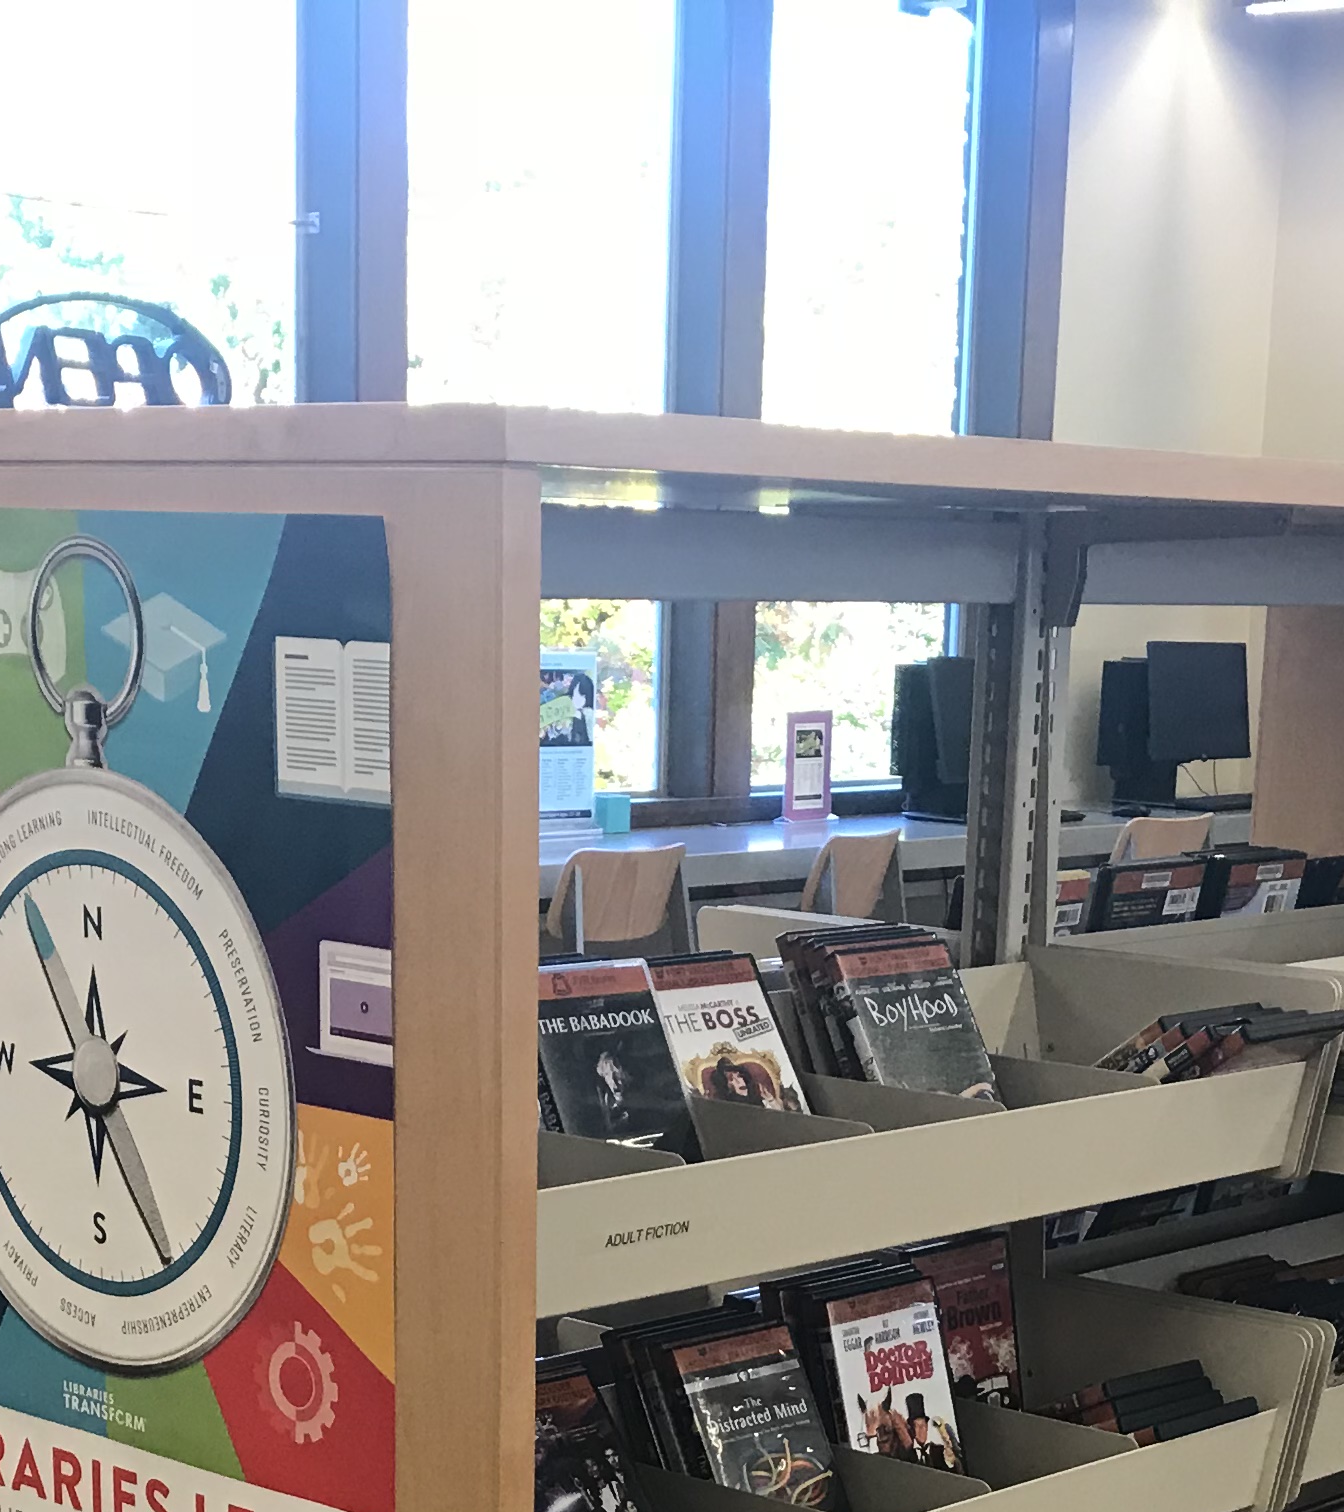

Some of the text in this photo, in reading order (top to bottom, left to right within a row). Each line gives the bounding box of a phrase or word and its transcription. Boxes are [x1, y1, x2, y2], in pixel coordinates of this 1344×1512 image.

[16, 810, 62, 843] LEARNING
[87, 809, 204, 900] INTELLECTUAL FREEDOM
[83, 903, 102, 940] N
[218, 928, 263, 1043] PRESERVATION
[538, 1008, 655, 1035] THE BABADOOK
[664, 1005, 760, 1034] THE BOSS
[188, 1078, 203, 1114] E
[256, 1087, 270, 1171] CURIOSITY
[93, 1211, 106, 1244] S
[225, 1205, 257, 1269] LITERACY
[605, 1220, 690, 1248] ADULT FICTION
[3, 1240, 38, 1287] PRIVACY
[59, 1297, 96, 1327] ACCESS
[121, 1284, 212, 1335] ENTREPRENEURSHIP
[946, 1300, 1003, 1331] Brown
[864, 1340, 932, 1373] DOCTOR
[63, 1380, 114, 1404] LIBRARIES
[742, 1396, 763, 1409] The
[707, 1398, 808, 1434] Distracted Mind
